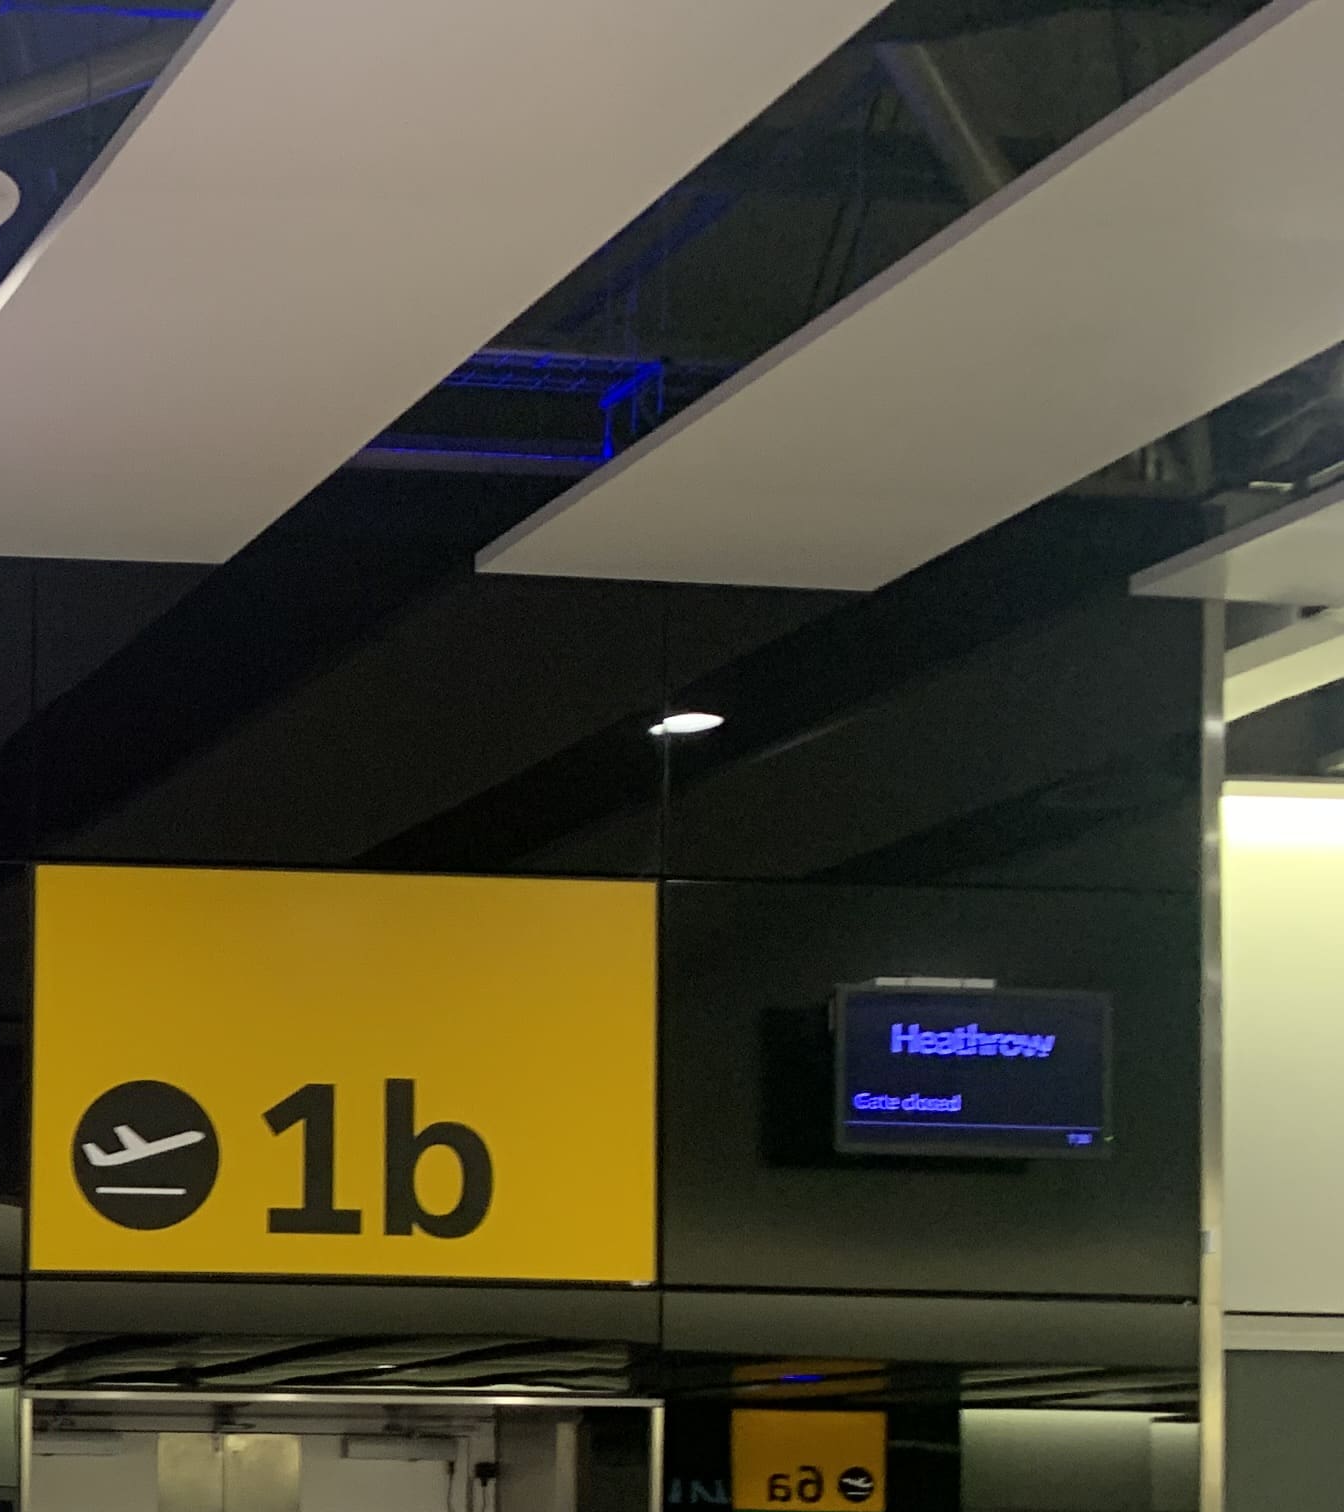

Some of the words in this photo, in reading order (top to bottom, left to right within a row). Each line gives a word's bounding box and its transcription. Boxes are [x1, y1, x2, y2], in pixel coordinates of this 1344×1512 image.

[890, 1023, 1055, 1057] Heathrow
[853, 1092, 900, 1110] Gate
[901, 1094, 962, 1111] closed
[262, 1078, 494, 1239] 1b
